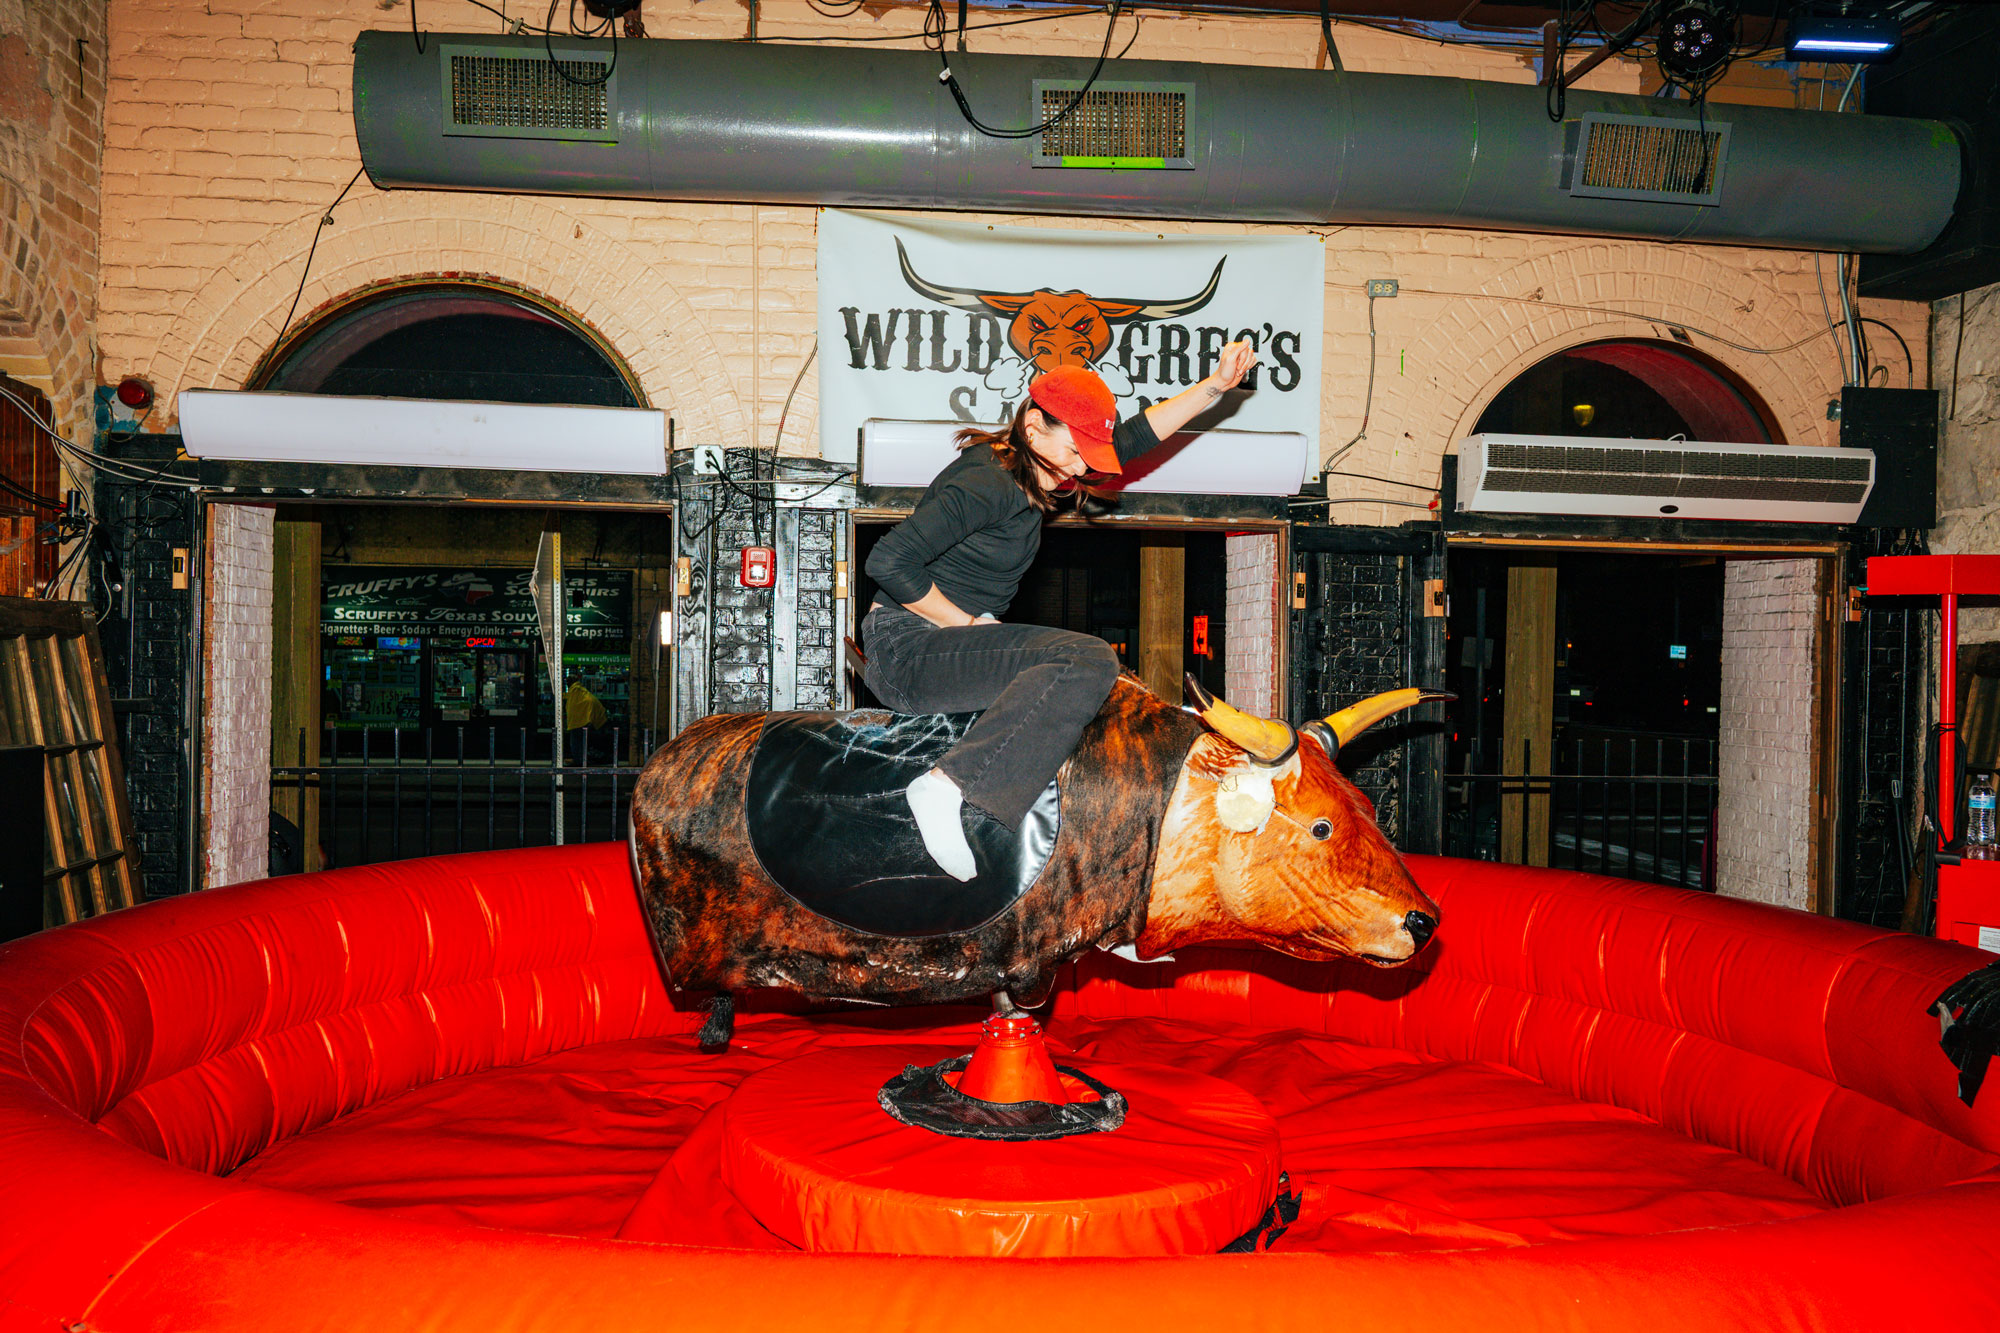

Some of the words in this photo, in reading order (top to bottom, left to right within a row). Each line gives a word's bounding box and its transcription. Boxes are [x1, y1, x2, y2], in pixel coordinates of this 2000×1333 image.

[838, 306, 1004, 375] WILD
[327, 574, 438, 599] CRUFFY'S
[334, 607, 419, 621] SCRUFFY'S
[425, 607, 487, 622] Texas
[491, 610, 582, 624] SOUVRS
[373, 624, 396, 635] Beer
[402, 624, 431, 635] Sodas
[439, 624, 472, 638] Energy
[473, 625, 506, 636] Drinks
[574, 627, 603, 640] Caps
[466, 637, 496, 648] OPEN
